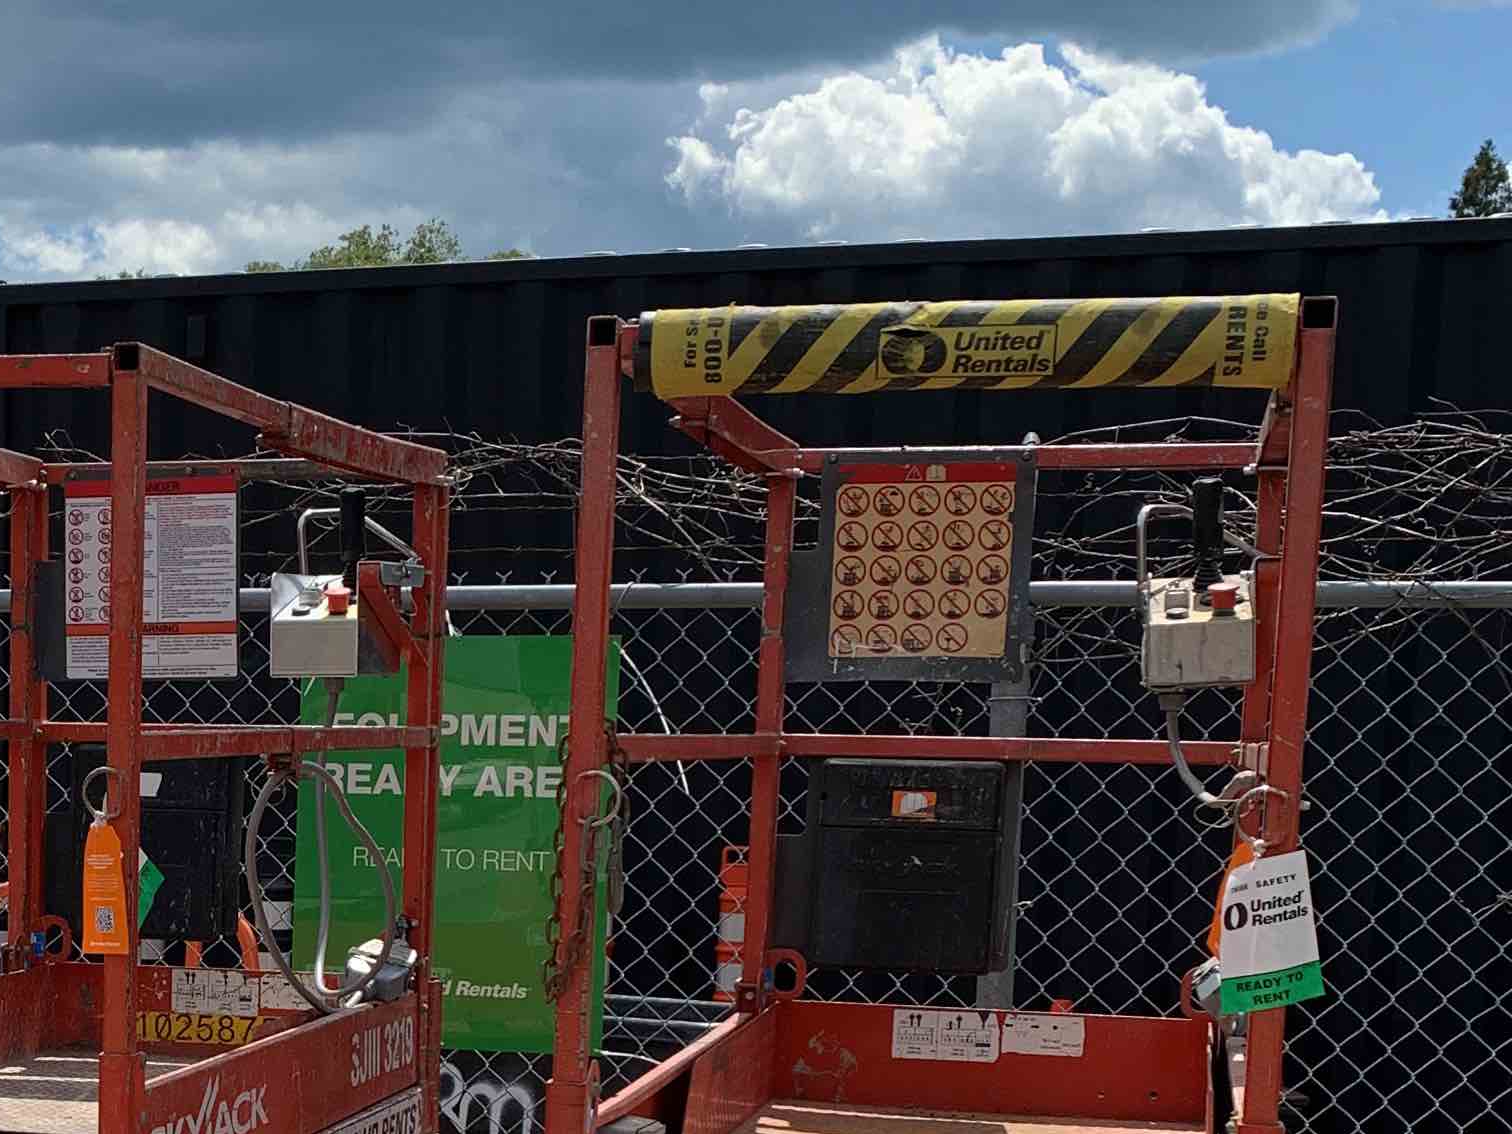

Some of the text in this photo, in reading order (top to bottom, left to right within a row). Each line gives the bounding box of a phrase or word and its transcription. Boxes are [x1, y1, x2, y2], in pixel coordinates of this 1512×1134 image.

[953, 330, 1051, 352] United
[1222, 306, 1248, 377] RENTS
[951, 353, 1052, 374] Rentals
[324, 762, 569, 799] REAY ARE
[440, 848, 476, 870] TO
[483, 849, 551, 873] RENT
[1255, 872, 1298, 889] SAFETY
[1250, 890, 1305, 913] United
[1251, 904, 1308, 928] Rentals
[455, 980, 530, 1000] Rentals
[1237, 970, 1305, 993] READY TO
[1253, 989, 1292, 1007] RENT
[137, 1013, 278, 1043] 102587
